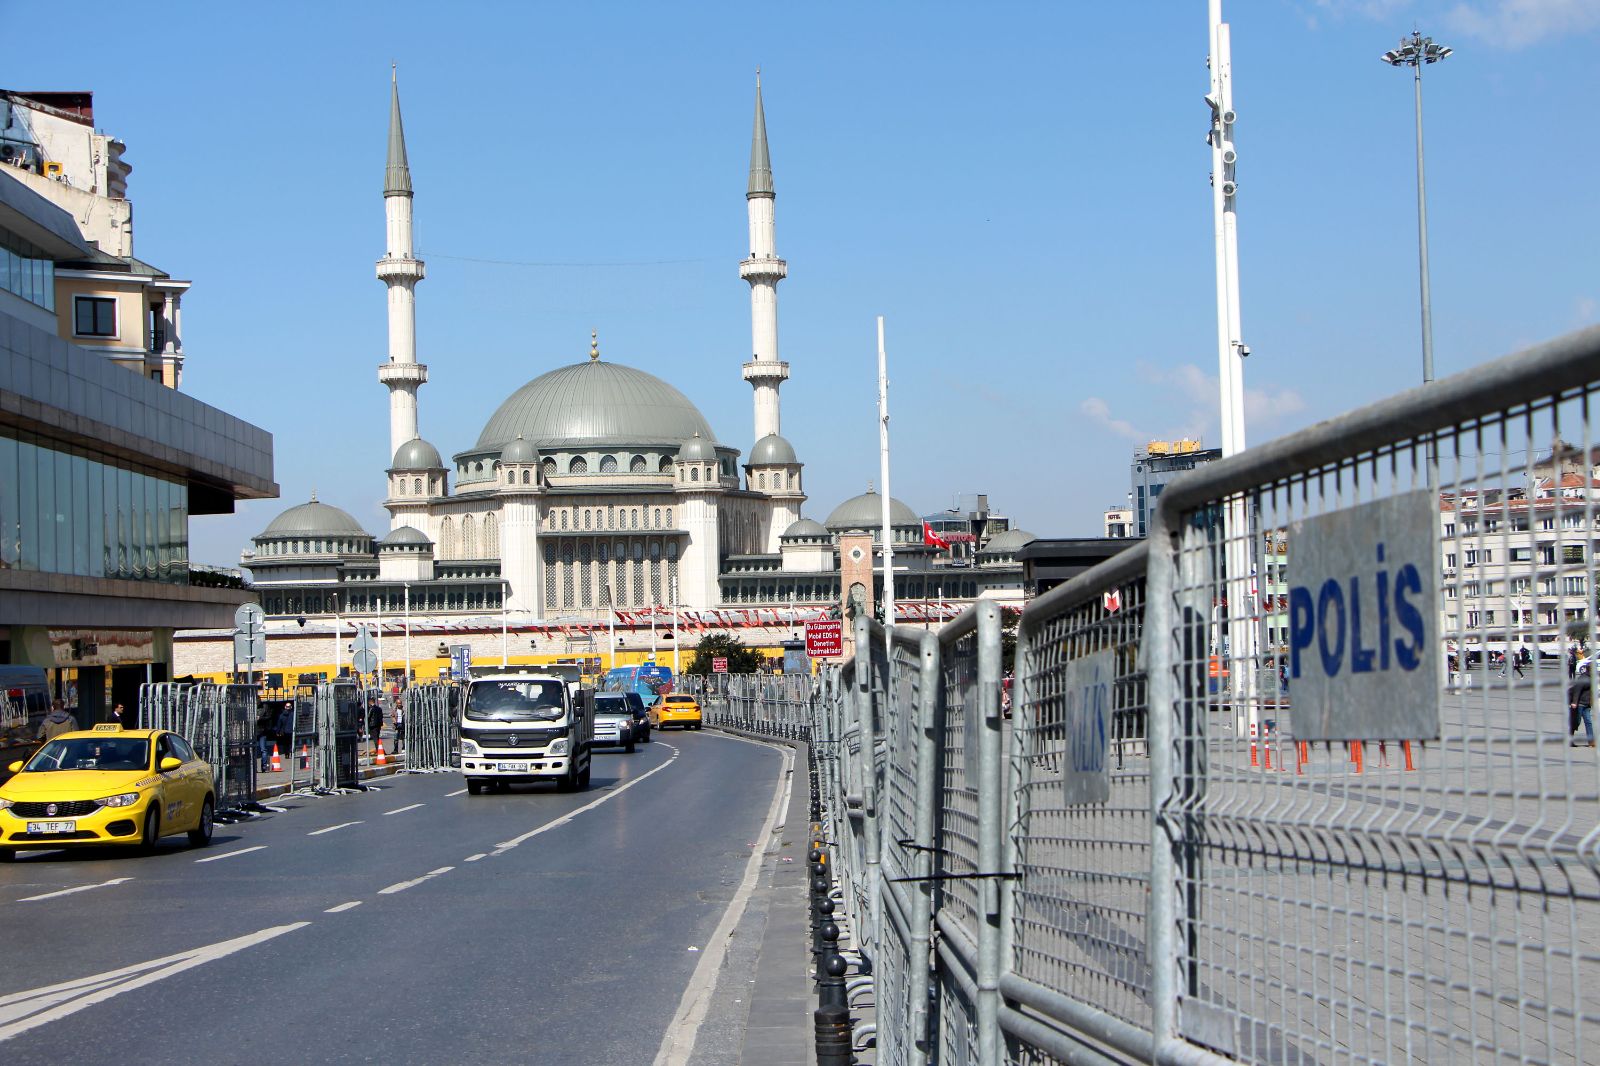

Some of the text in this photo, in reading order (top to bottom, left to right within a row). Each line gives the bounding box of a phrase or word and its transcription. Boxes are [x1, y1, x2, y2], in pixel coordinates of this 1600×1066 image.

[1290, 541, 1425, 679] POLİS
[32, 822, 74, 831] 34 TEF 77
